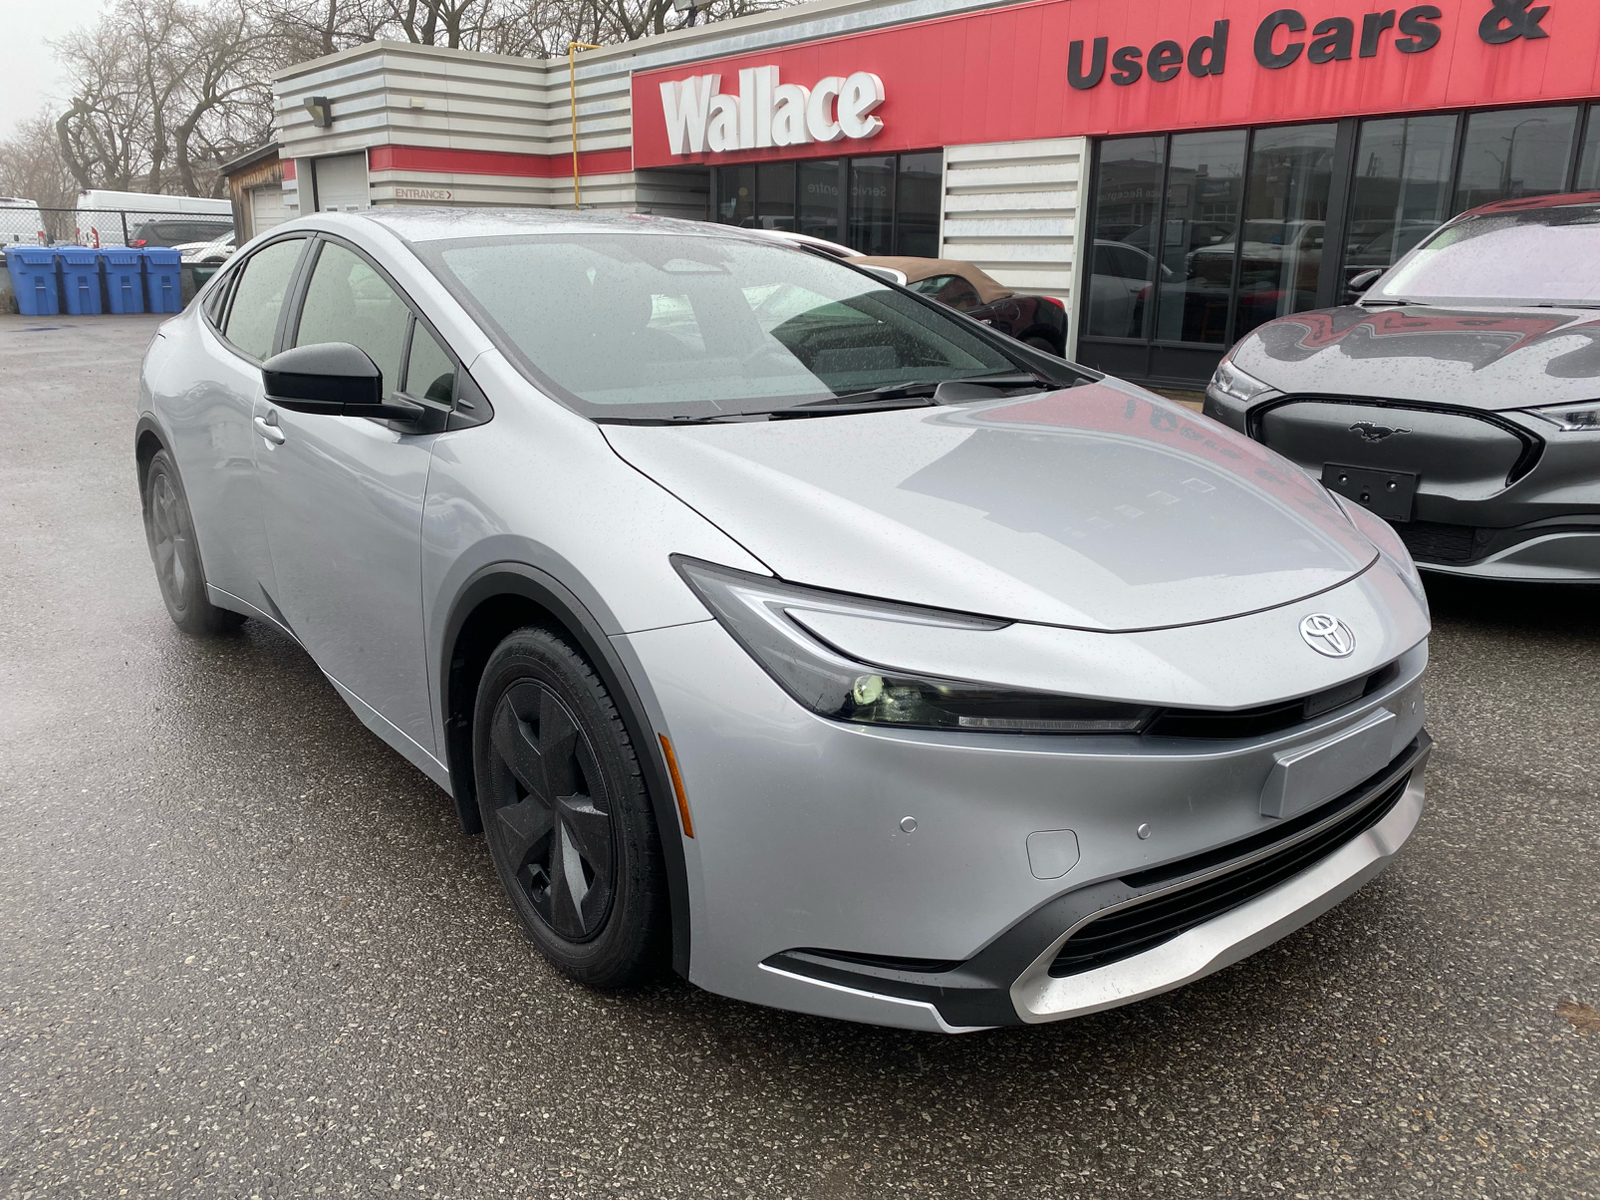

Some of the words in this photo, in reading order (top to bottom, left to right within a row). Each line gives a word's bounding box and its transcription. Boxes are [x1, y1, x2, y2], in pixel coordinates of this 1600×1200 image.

[1067, 18, 1230, 90] Used
[1253, 5, 1442, 69] Cars
[1478, 0, 1550, 45] &
[659, 65, 886, 155] Wallace
[395, 188, 445, 199] ENTRANCE
